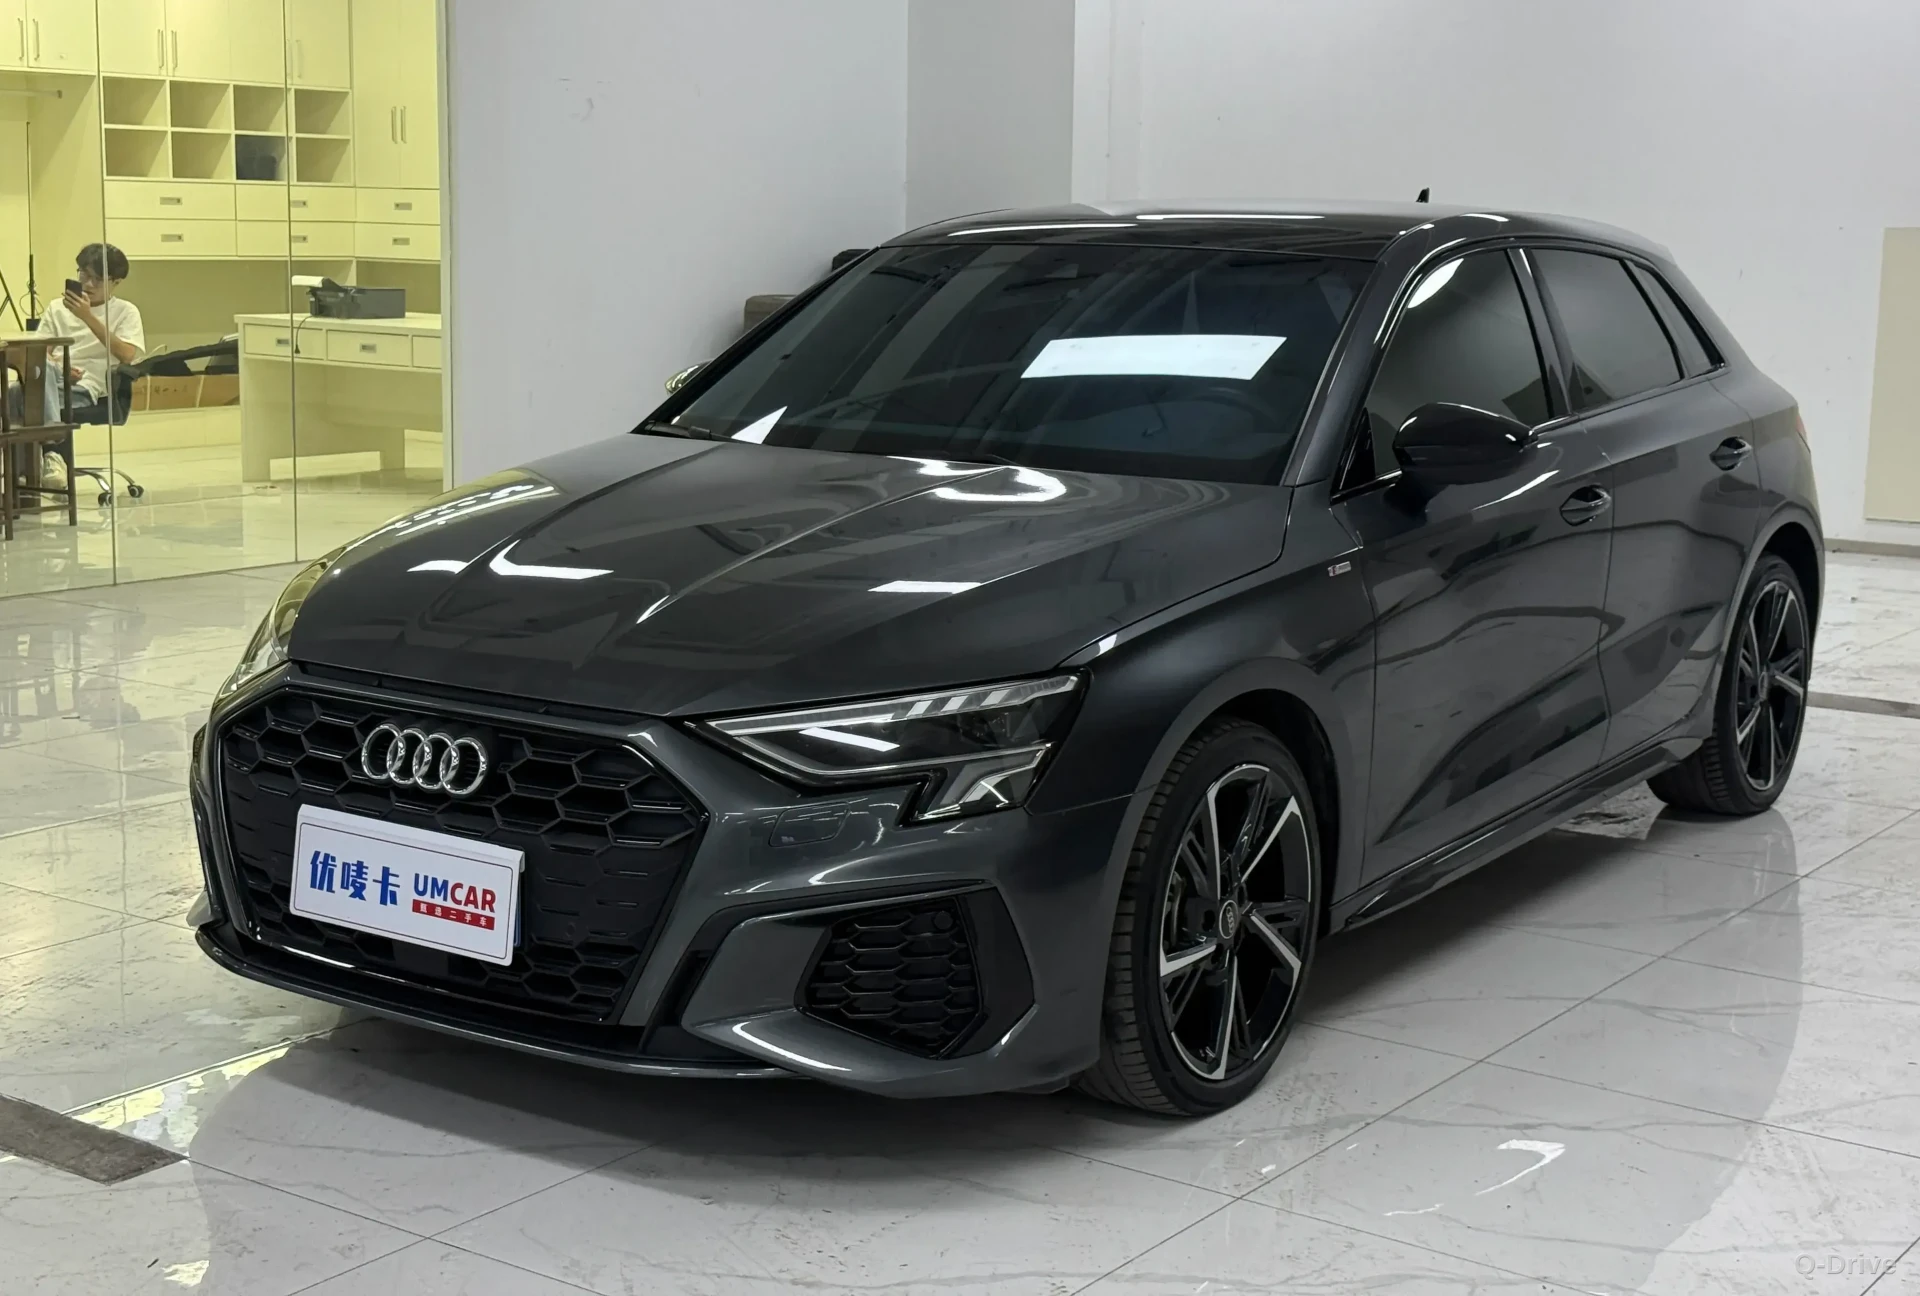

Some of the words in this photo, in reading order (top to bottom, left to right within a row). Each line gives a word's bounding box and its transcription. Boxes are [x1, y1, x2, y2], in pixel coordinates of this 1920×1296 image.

[310, 850, 400, 906] 优唛卡
[413, 873, 496, 913] UMCAR
